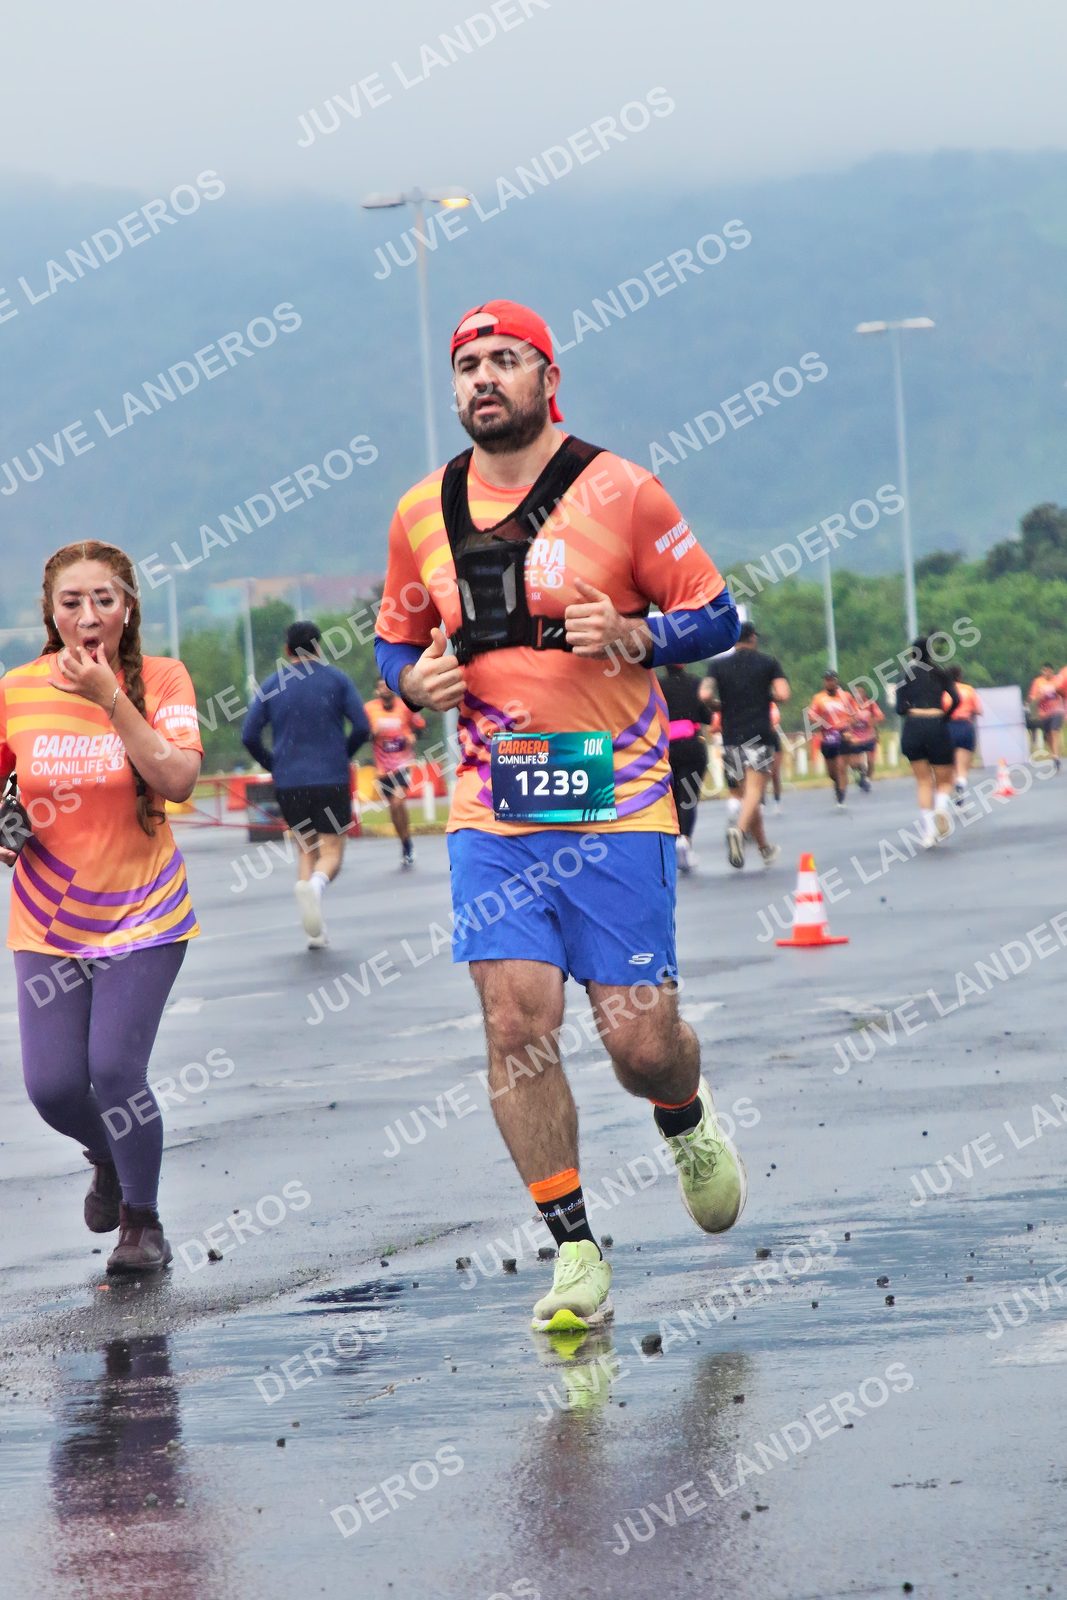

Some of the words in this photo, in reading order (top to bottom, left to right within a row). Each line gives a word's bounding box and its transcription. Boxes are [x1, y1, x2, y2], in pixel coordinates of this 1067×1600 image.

[498, 740, 550, 755] CARRERA
[583, 738, 604, 756] 10K
[31, 759, 104, 777] OMNILIFE
[497, 755, 537, 765] OMNILIFE
[515, 769, 589, 796] 1239
